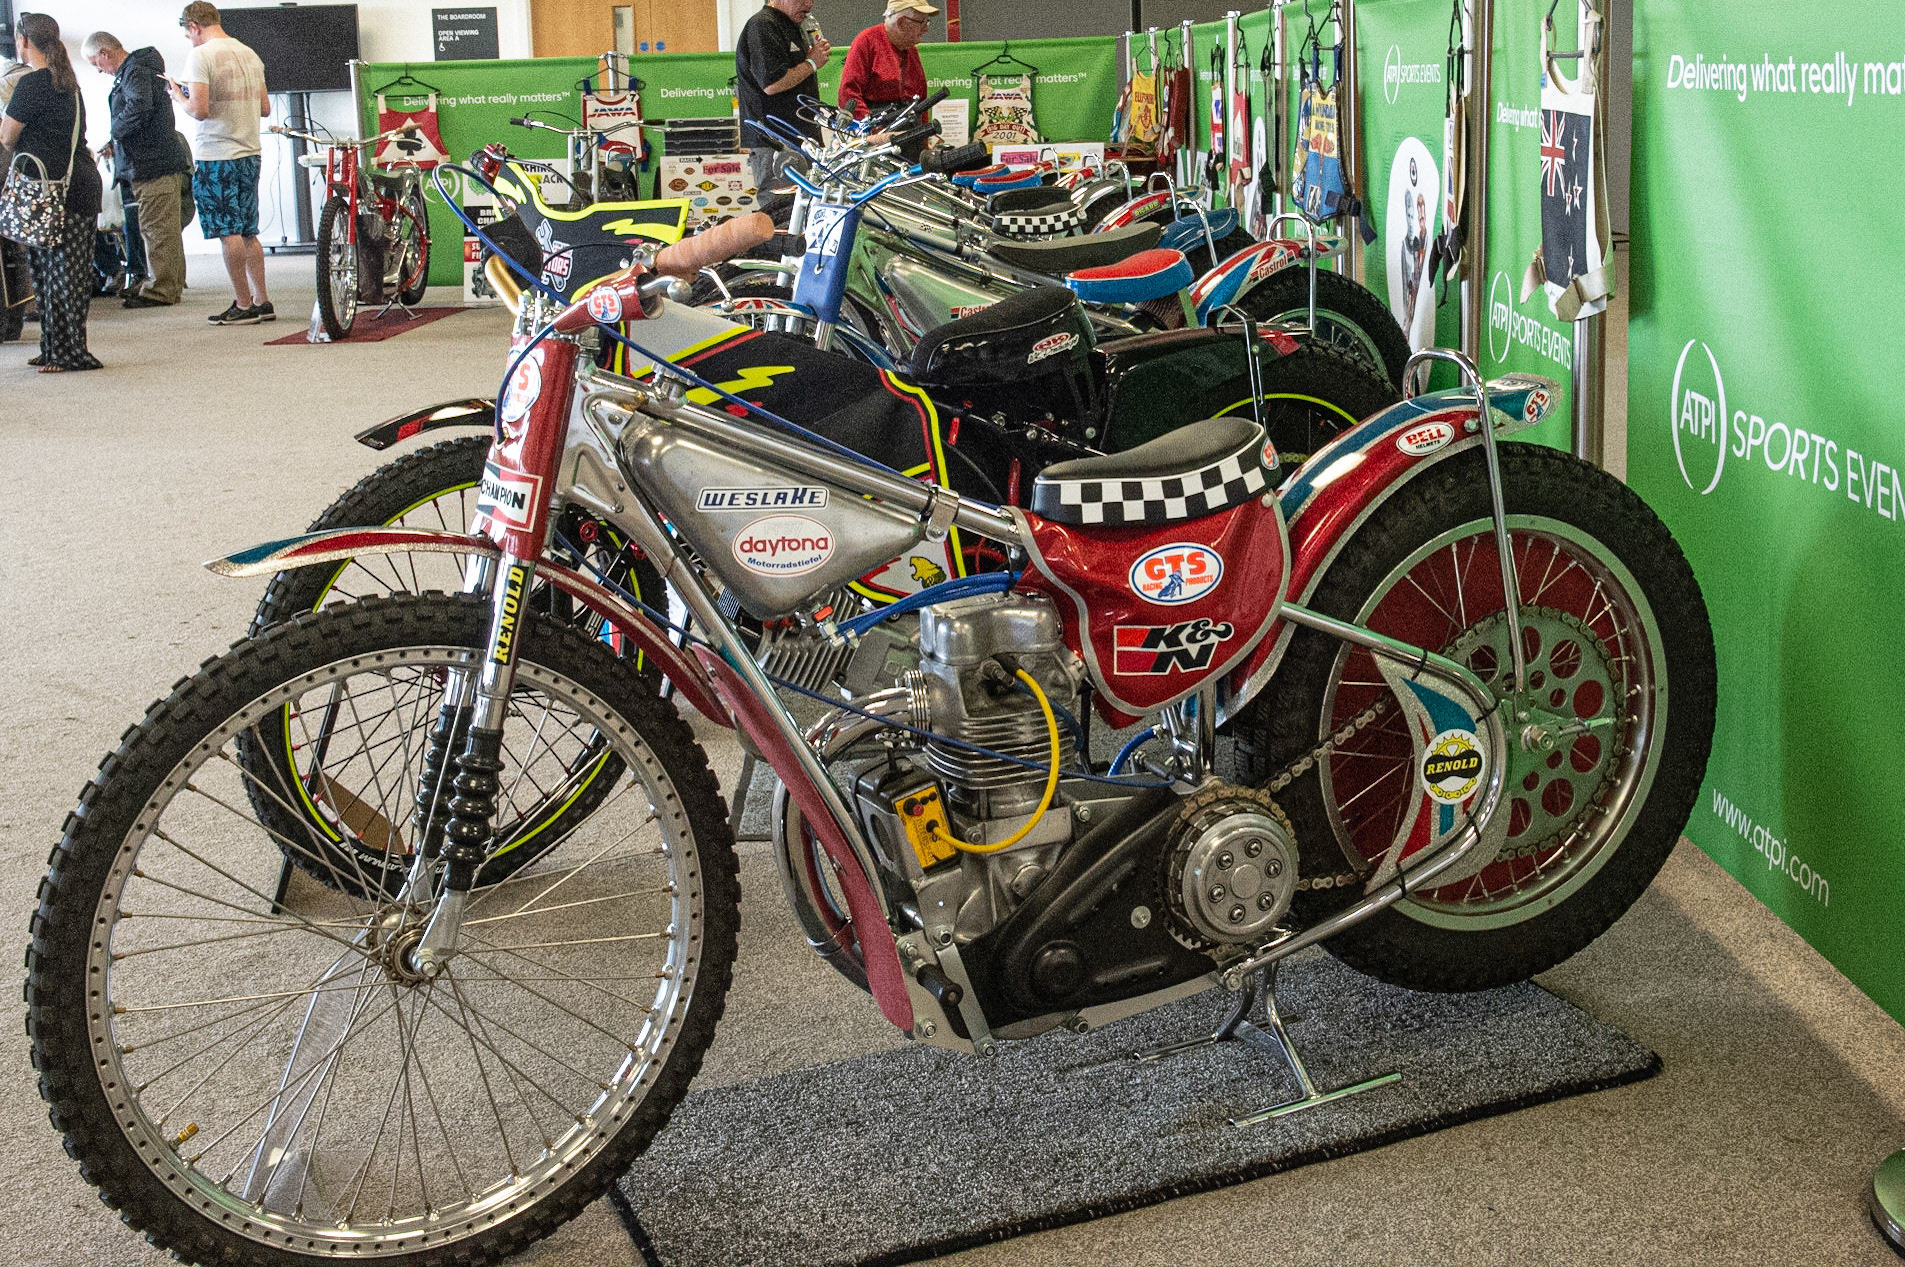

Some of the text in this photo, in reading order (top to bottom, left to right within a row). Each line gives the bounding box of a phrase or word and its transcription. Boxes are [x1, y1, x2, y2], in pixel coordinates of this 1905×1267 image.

[1400, 64, 1420, 84] SPORTS
[1420, 63, 1441, 83] EVENTS
[1666, 51, 1905, 107] Delivering what really ma
[927, 78, 972, 88] elivering
[403, 96, 456, 107] Delivring
[459, 95, 487, 104] what
[488, 93, 517, 106] really
[630, 93, 637, 102] 7
[660, 88, 714, 98] Delivering
[588, 107, 637, 118] JAWA
[1496, 101, 1538, 132] Delivering what
[993, 132, 1017, 140] 2001
[1001, 152, 1038, 164] For Sale
[703, 164, 741, 175] For Sale
[425, 178, 452, 190] API
[1258, 256, 1288, 278] Castrol
[593, 294, 616, 308] GTS
[1491, 301, 1571, 370] ATPI SPORTS EVENTS
[1526, 391, 1545, 415] GTS
[1405, 427, 1446, 445] BELL
[1415, 440, 1441, 449] HELMETS
[1680, 388, 1716, 445] ATPI
[1732, 410, 1839, 491] SPORTS
[480, 479, 526, 510] CHAMPION
[704, 487, 824, 507] WESLAKE
[739, 536, 829, 557] daytona
[747, 554, 822, 569] Motorradstiefel
[1144, 552, 1207, 581] GTS
[1142, 575, 1214, 592] RACING PRODUCTS
[493, 566, 525, 664] RENOLD
[1425, 757, 1479, 775] RENOLD
[1712, 788, 1829, 907] www.atpi.com
